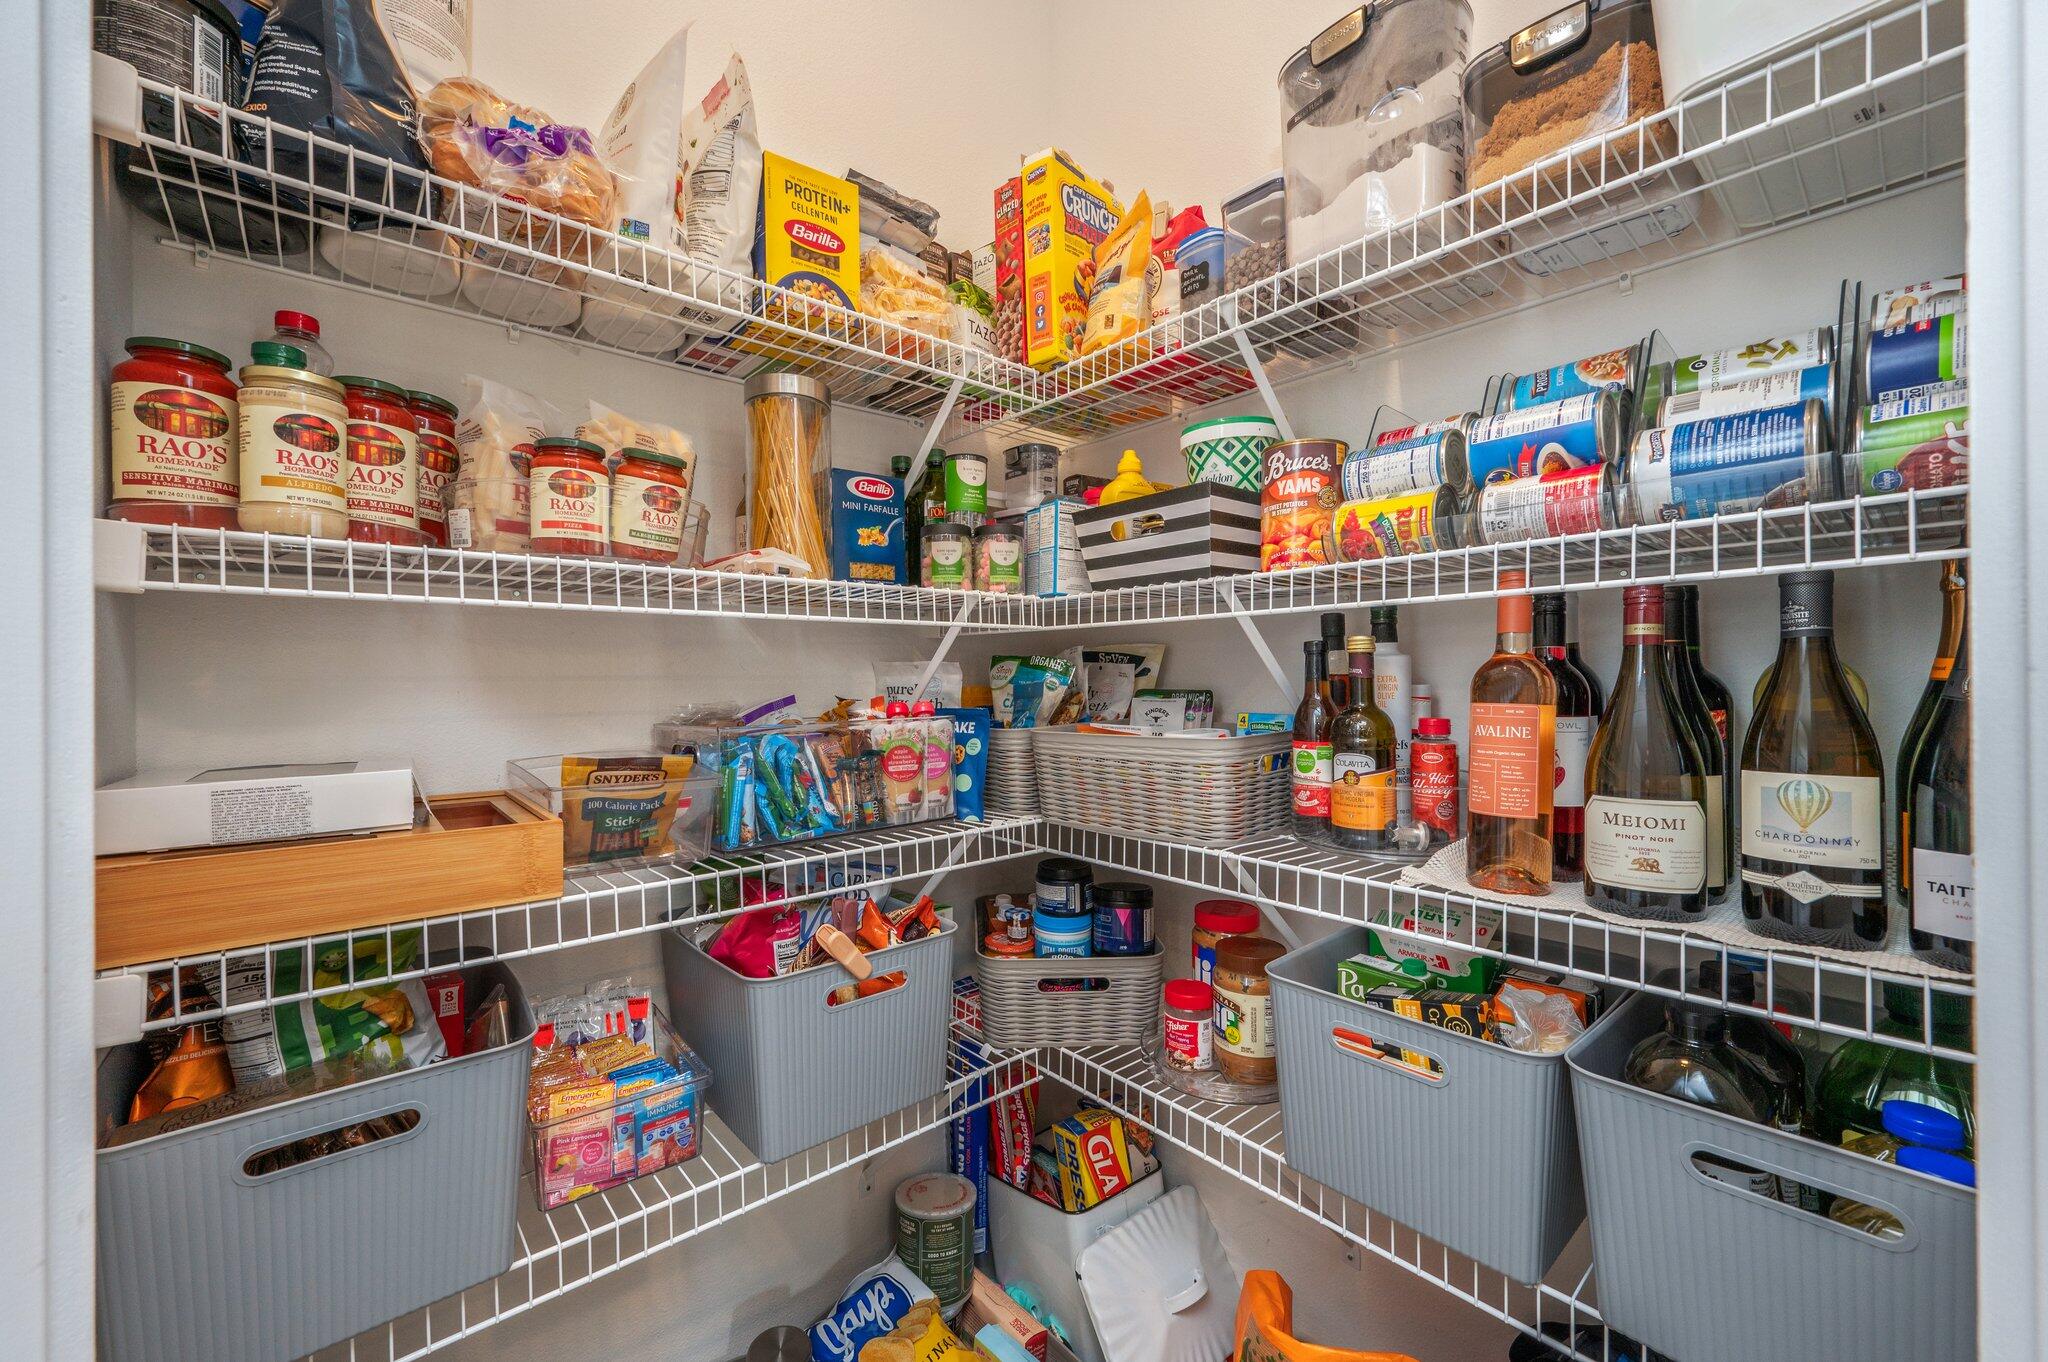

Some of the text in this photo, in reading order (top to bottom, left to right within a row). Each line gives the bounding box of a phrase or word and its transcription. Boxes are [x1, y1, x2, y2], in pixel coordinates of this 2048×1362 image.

[784, 178, 851, 214] PROTEIN+
[791, 201, 838, 226] CELLENTANI
[996, 198, 1019, 220] GLAZED
[1062, 186, 1120, 234] CRUNCH
[792, 223, 840, 250] Barilla
[974, 253, 995, 270] TAZO
[967, 318, 998, 346] TAZO
[1910, 388, 1922, 398] 20
[136, 434, 227, 464] RAO'S
[146, 456, 219, 472] HOMEMADE
[276, 448, 339, 474] RAO'S
[1264, 450, 1332, 486] Bruce's
[284, 466, 335, 480] HOMEMADE
[346, 466, 404, 488] AO'S
[123, 472, 239, 492] SENSITIVE MARINARA
[286, 480, 332, 493] ALFREDO
[346, 484, 397, 496] OMEMADE
[858, 480, 891, 496] Barilla
[1276, 478, 1320, 496] YAMS
[370, 500, 414, 514] MARINARA
[549, 498, 596, 514] RAO'S
[842, 500, 900, 516] MINI FARFALLE
[1277, 508, 1292, 516] SYRUP
[1282, 500, 1308, 509] POTATOES
[641, 510, 678, 527] RAO'S
[1382, 517, 1394, 541] DICED
[1030, 656, 1066, 672] ORGANIC
[1240, 716, 1246, 724] 4
[1252, 723, 1286, 732] Hidden Valley
[1474, 724, 1532, 739] AVALINE
[1335, 758, 1370, 768] COLAVITA
[593, 772, 660, 785] SNYDER'S
[1428, 772, 1454, 784] Hot
[1413, 778, 1454, 799] Honey
[588, 800, 661, 811] 100 Calorie Pack
[604, 816, 642, 828] Sticks
[1602, 811, 1686, 831] MEIOMI
[1615, 832, 1646, 841] PINOT
[1754, 830, 1861, 847] CHARDONNAY
[1782, 848, 1827, 857] CALIFORNIA
[830, 872, 872, 888] CAPE
[1786, 882, 1824, 892] EXQUISITE
[1410, 907, 1462, 927] LARD
[1397, 948, 1428, 960] ARMOUR
[444, 990, 454, 1002] 8
[1166, 1020, 1189, 1032] Fisher
[560, 1090, 602, 1102] Emergen-C
[646, 1100, 684, 1118] IMMUNE+
[1092, 1114, 1114, 1128] GLAD
[556, 1131, 603, 1144] Pink Lemonade
[1022, 1120, 1031, 1166] STORAGE
[1000, 1130, 1011, 1174] STORAGE
[1088, 1134, 1120, 1198] GLA
[816, 1280, 895, 1357] Lay's
